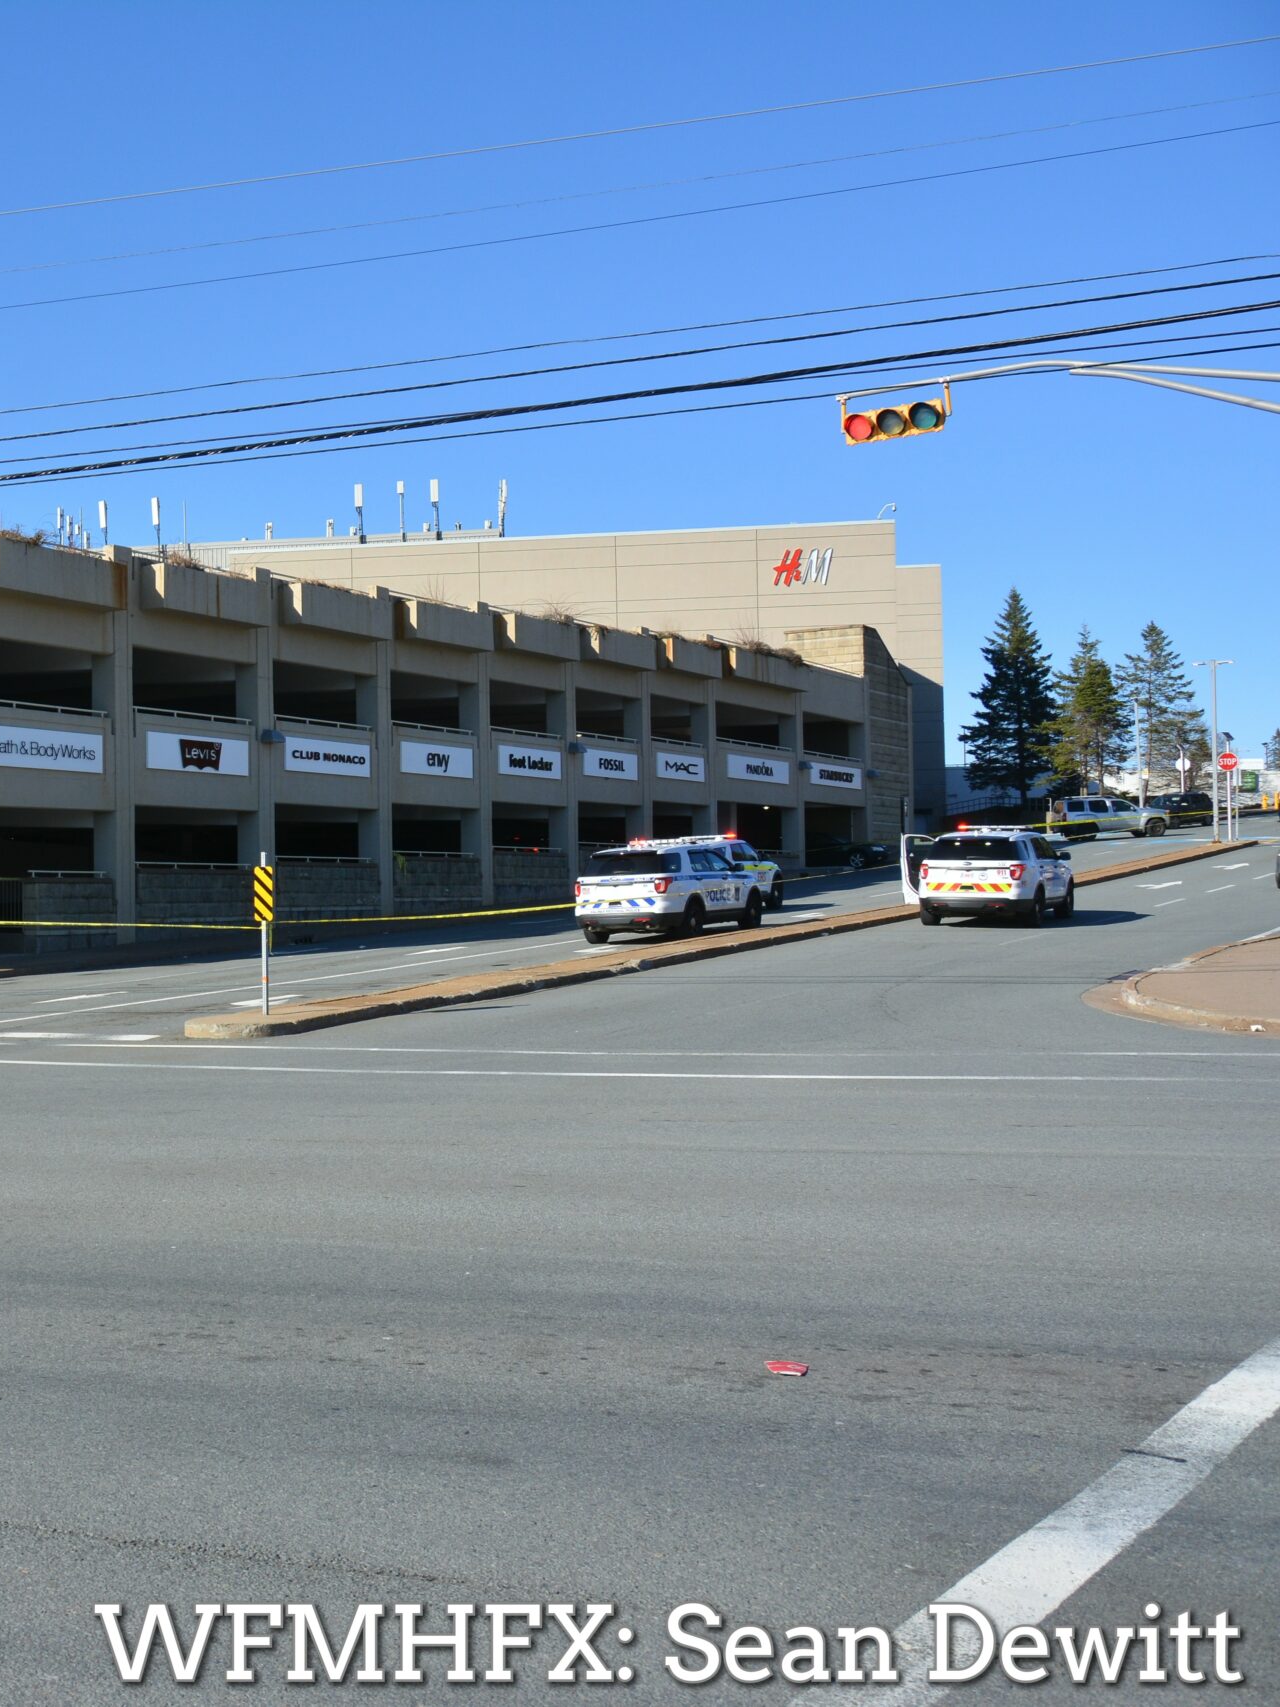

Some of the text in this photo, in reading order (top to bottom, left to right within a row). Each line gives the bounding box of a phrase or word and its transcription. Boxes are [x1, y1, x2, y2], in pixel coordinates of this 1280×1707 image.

[773, 548, 833, 587] H&M
[20, 741, 29, 755] &
[292, 750, 366, 765] CLUB MONACO
[426, 752, 450, 773] envy
[509, 753, 526, 769] Foot
[599, 757, 625, 772] FOSSIL
[1219, 758, 1237, 766] STOP
